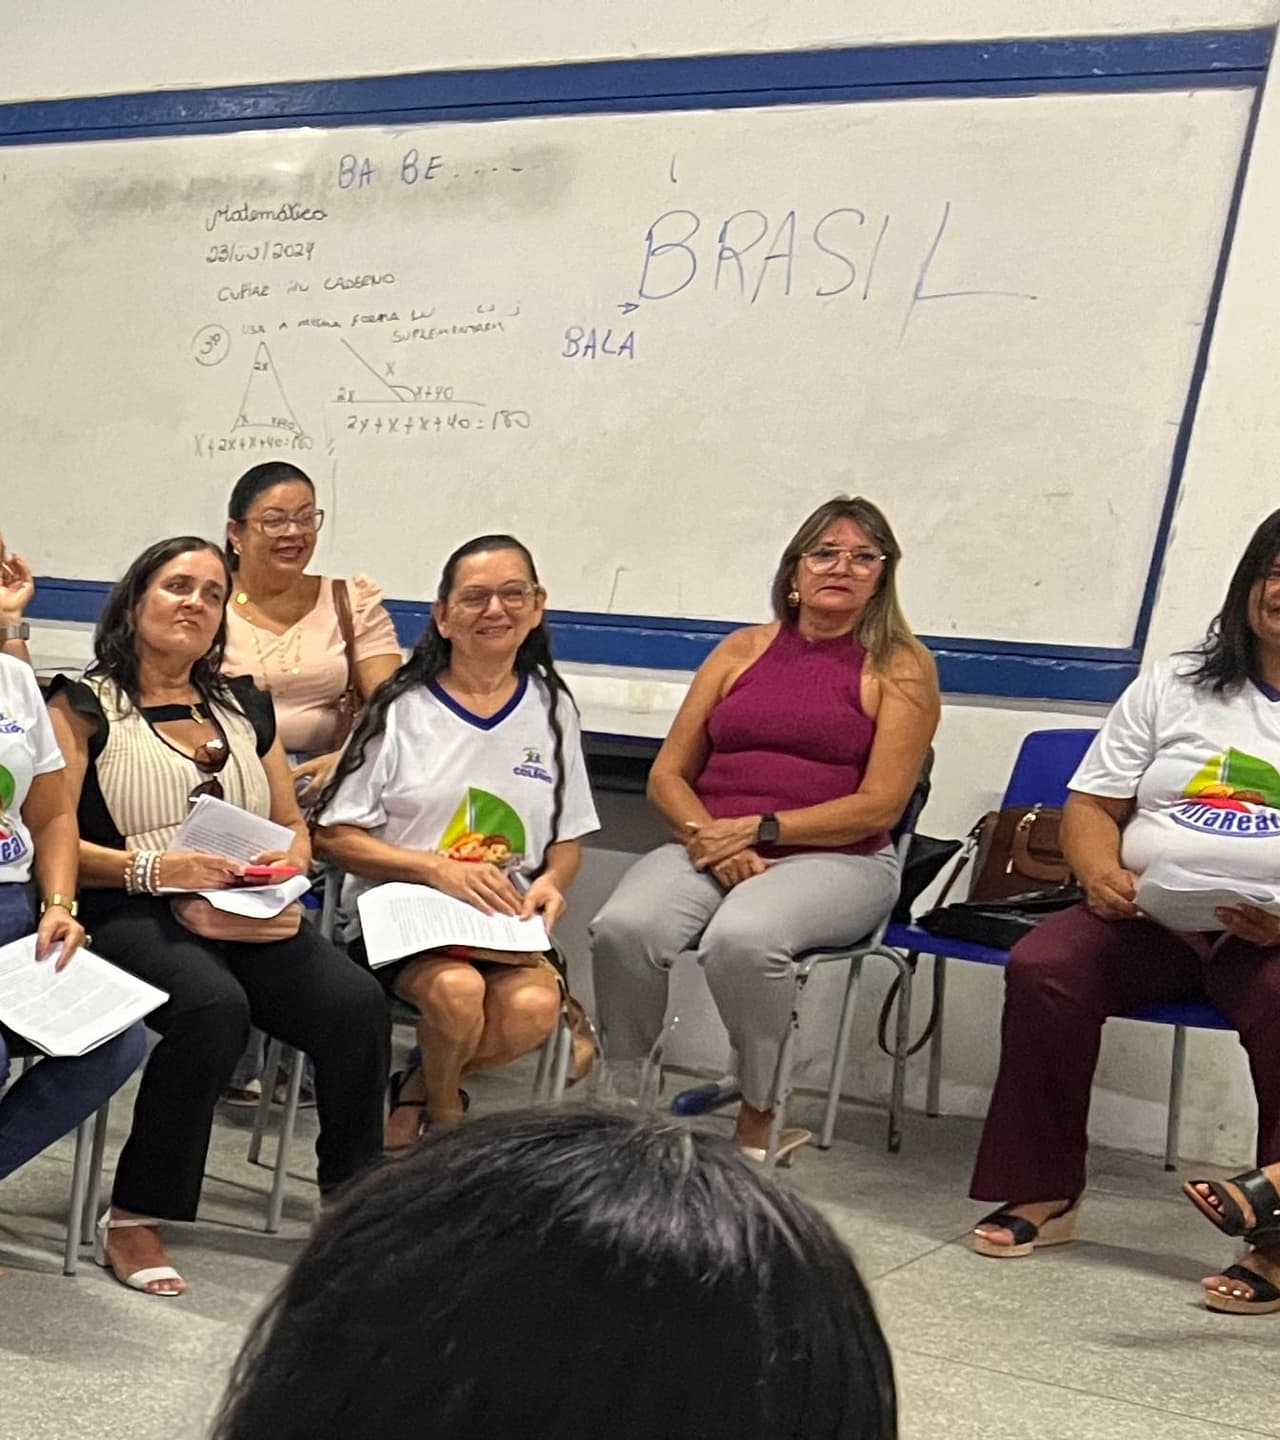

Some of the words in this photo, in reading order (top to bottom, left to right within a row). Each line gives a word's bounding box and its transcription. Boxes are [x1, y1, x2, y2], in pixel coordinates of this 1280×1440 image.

[339, 154, 376, 188] BA
[639, 202, 1037, 348] BRASIL
[561, 325, 636, 361] BALA
